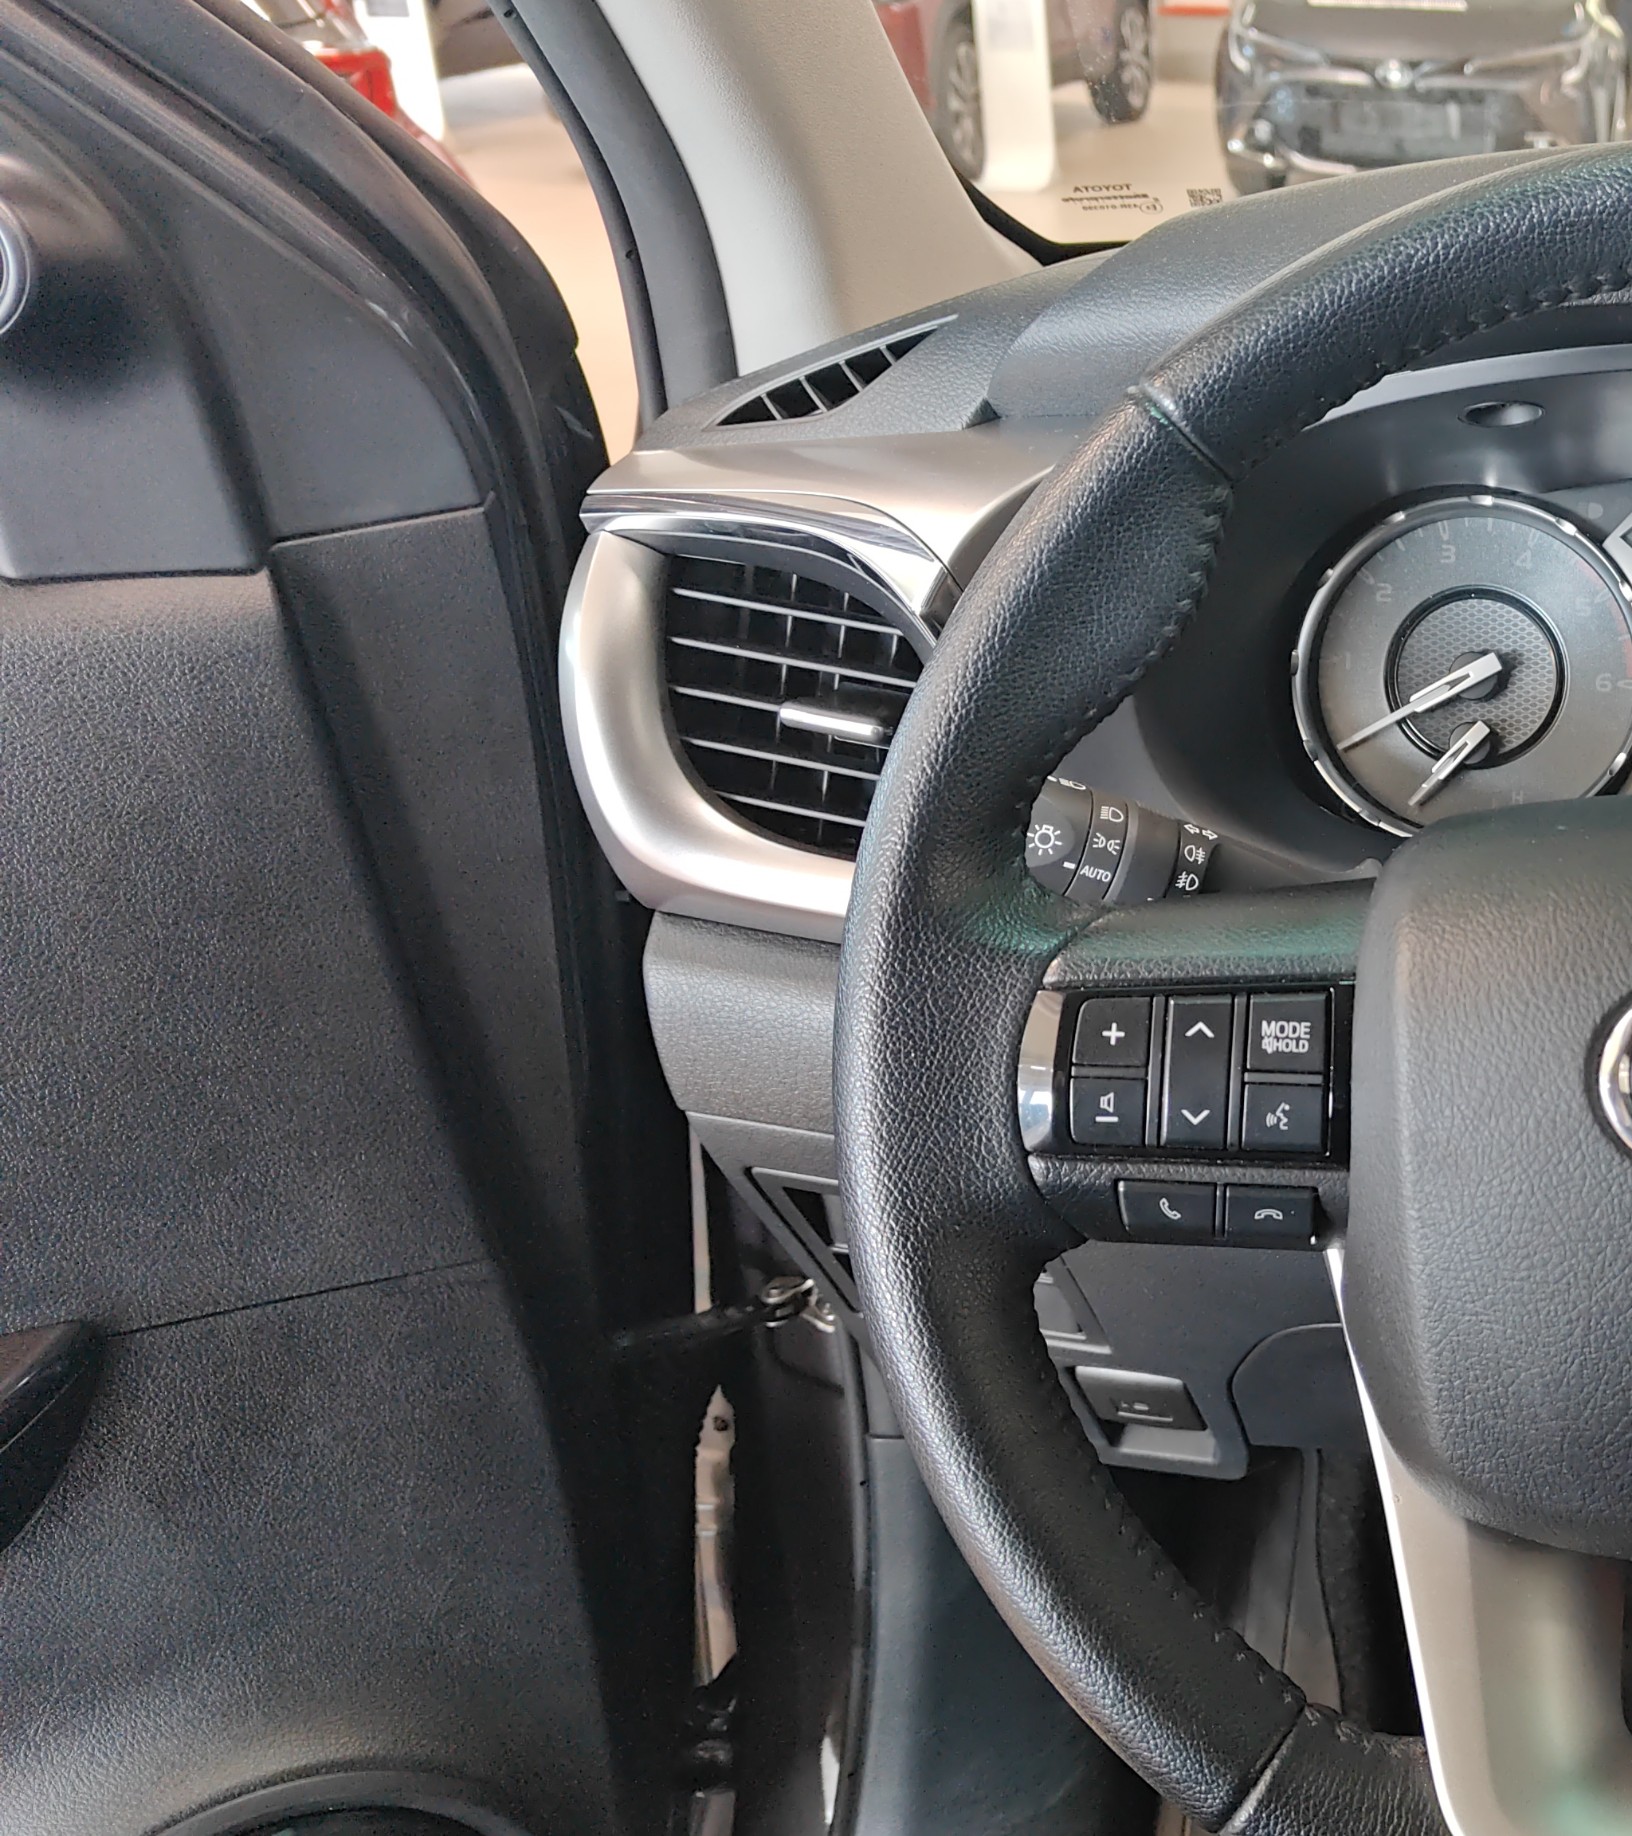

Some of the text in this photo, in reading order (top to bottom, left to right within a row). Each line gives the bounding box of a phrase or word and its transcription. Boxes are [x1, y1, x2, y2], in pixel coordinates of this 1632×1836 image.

[1440, 546, 1456, 562] 3
[1515, 551, 1532, 568] 4
[1376, 584, 1392, 602] 2
[1576, 599, 1592, 616] 5
[1596, 673, 1611, 691] 6
[1080, 864, 1111, 883] AUTO
[1261, 1020, 1311, 1039] MODE
[1273, 1038, 1309, 1053] HOLD
